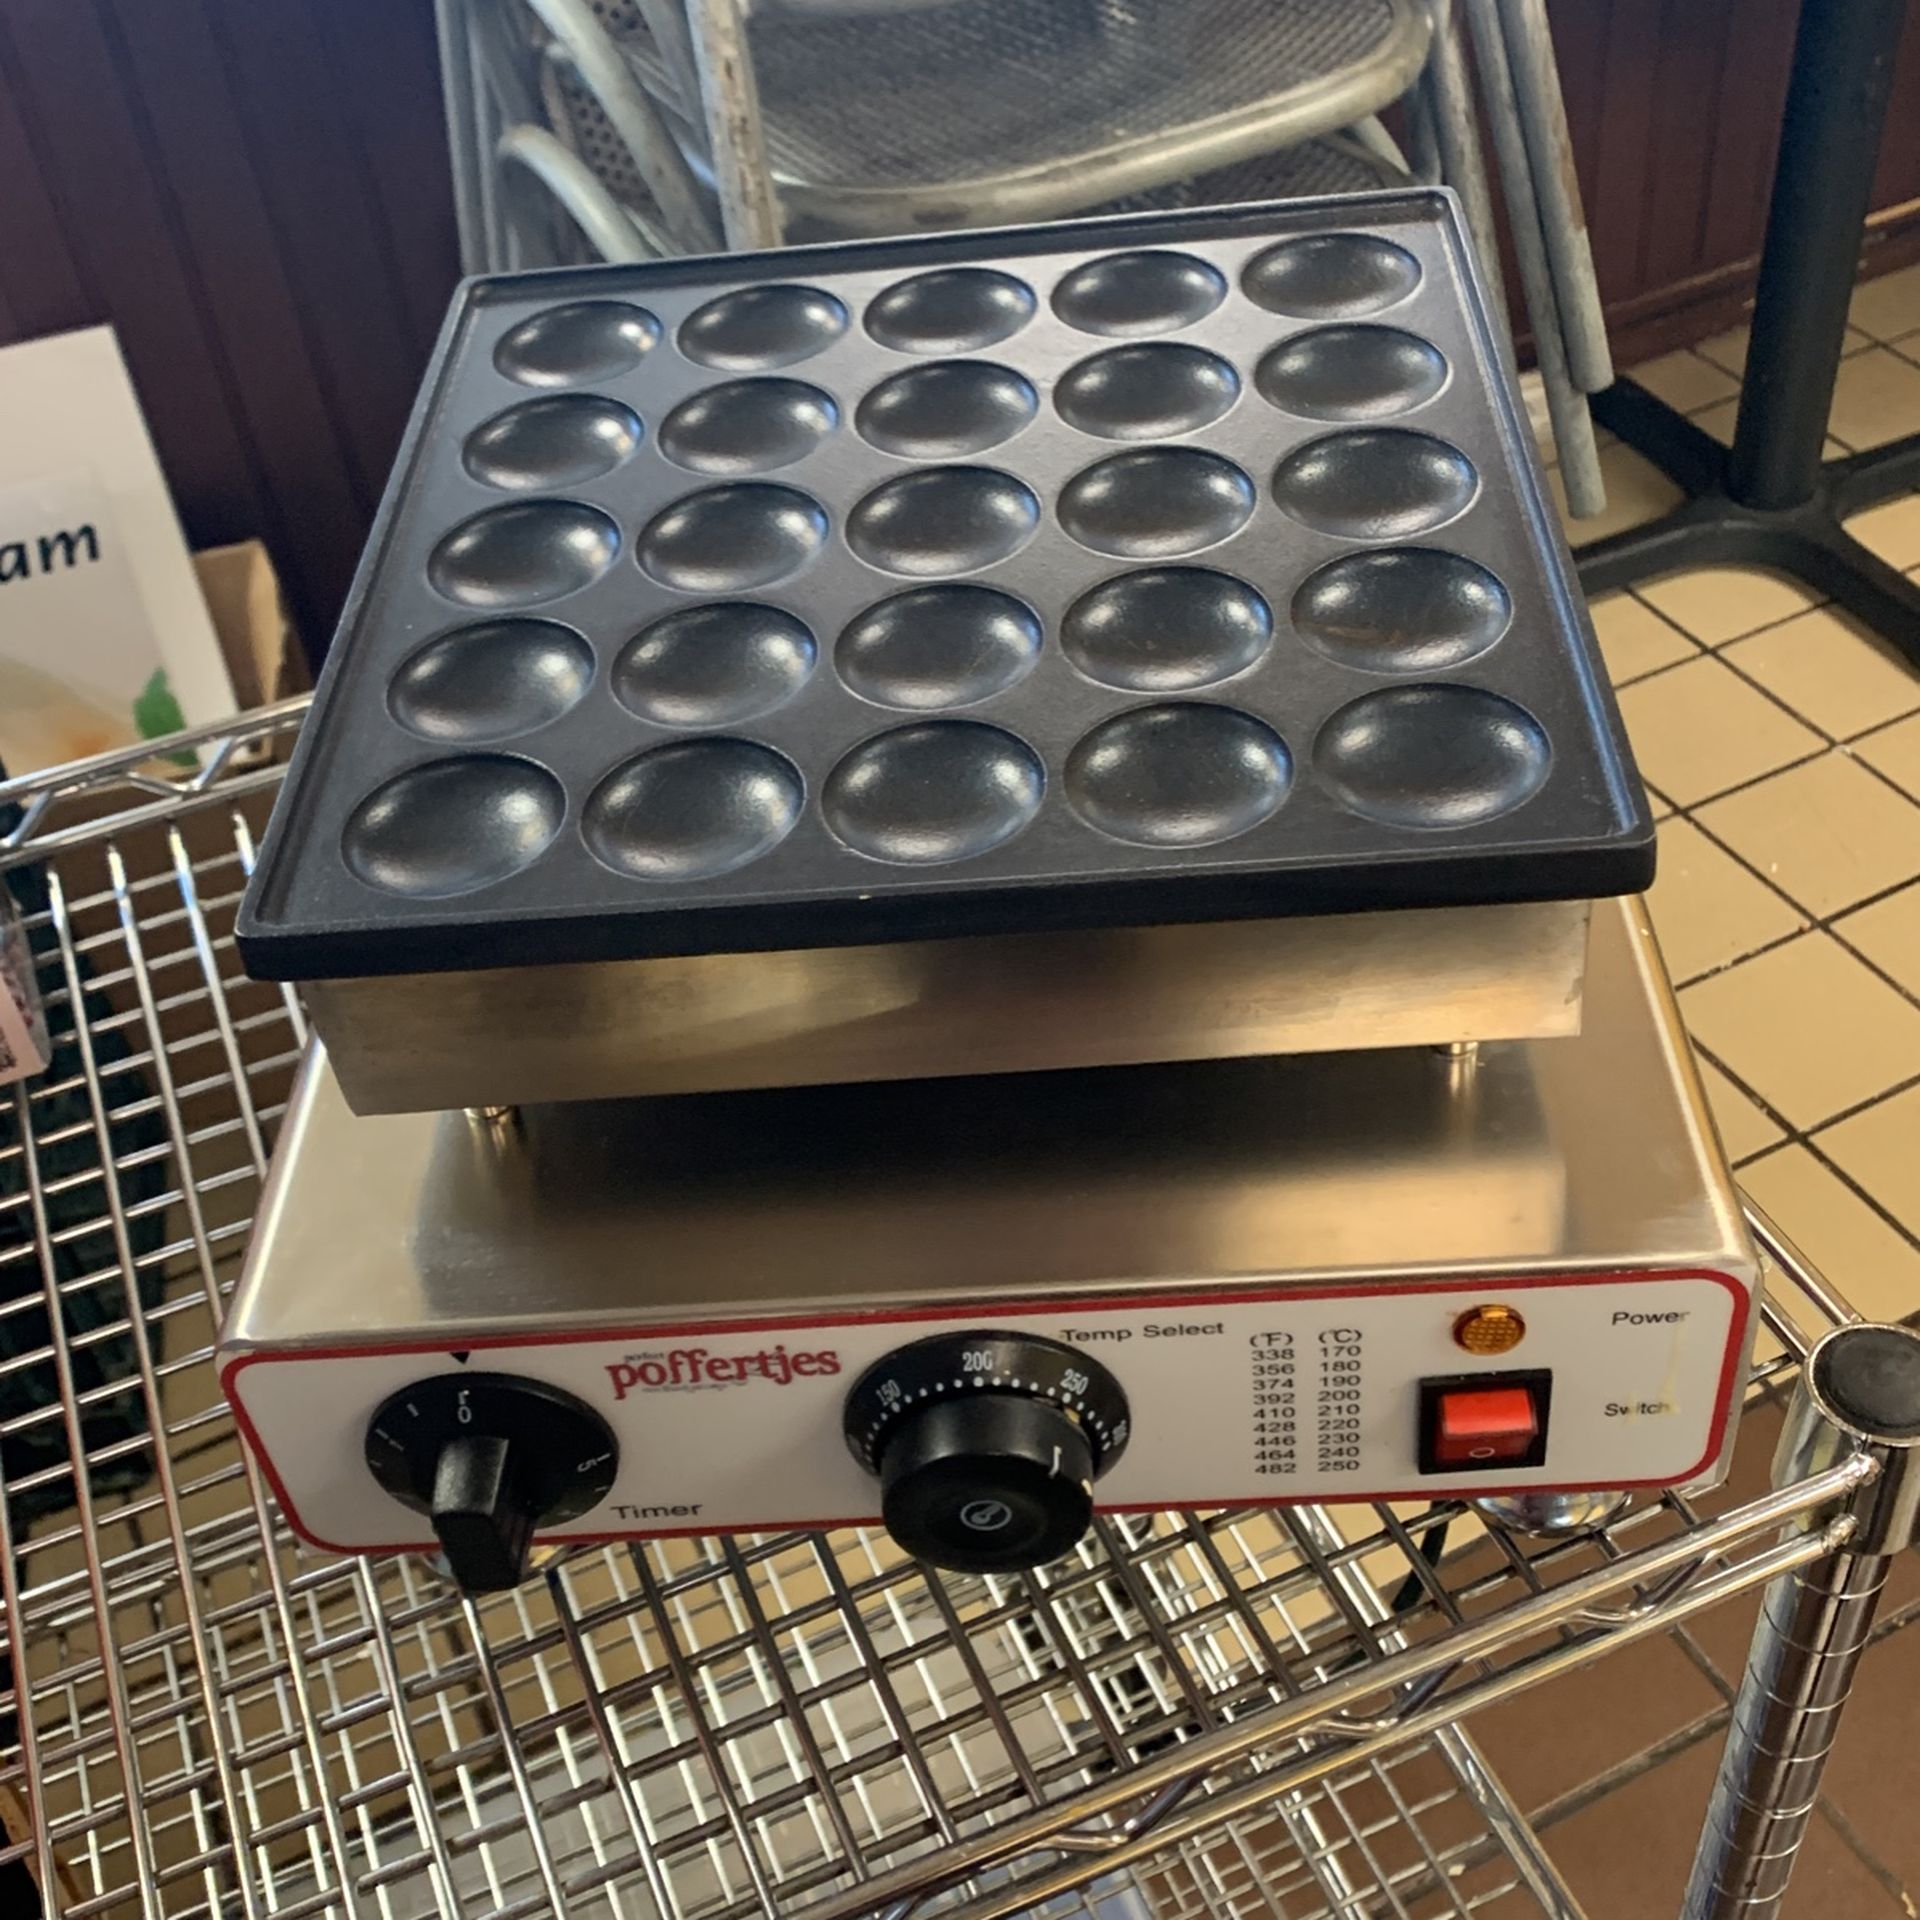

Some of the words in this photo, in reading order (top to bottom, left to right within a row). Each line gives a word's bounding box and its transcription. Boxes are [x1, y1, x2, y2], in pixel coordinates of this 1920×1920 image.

[1612, 1311, 1691, 1326] Power
[1061, 1328, 1133, 1342] Temp
[1143, 1322, 1224, 1339] Select
[962, 1350, 993, 1372] 200
[1251, 1348, 1295, 1361] 338
[1320, 1345, 1361, 1358] 170
[604, 1345, 842, 1401] poffertjes
[1252, 1363, 1295, 1376] 356
[1320, 1360, 1361, 1372] 180
[1060, 1368, 1089, 1395] 250
[1252, 1378, 1294, 1391] 374
[1320, 1374, 1361, 1387] 190
[875, 1379, 901, 1406] 150
[1253, 1392, 1295, 1405] 392
[1318, 1389, 1361, 1402] 200
[1253, 1406, 1296, 1419] 410
[1318, 1403, 1360, 1417] 210
[1253, 1420, 1296, 1433] 428
[1318, 1418, 1360, 1431] 220
[1254, 1435, 1296, 1446] 446
[1318, 1432, 1361, 1445] 230
[1254, 1449, 1296, 1460] 464
[1318, 1446, 1360, 1459] 240
[1254, 1462, 1296, 1474] 482
[1318, 1460, 1360, 1472] 250
[609, 1504, 703, 1520] Timer
